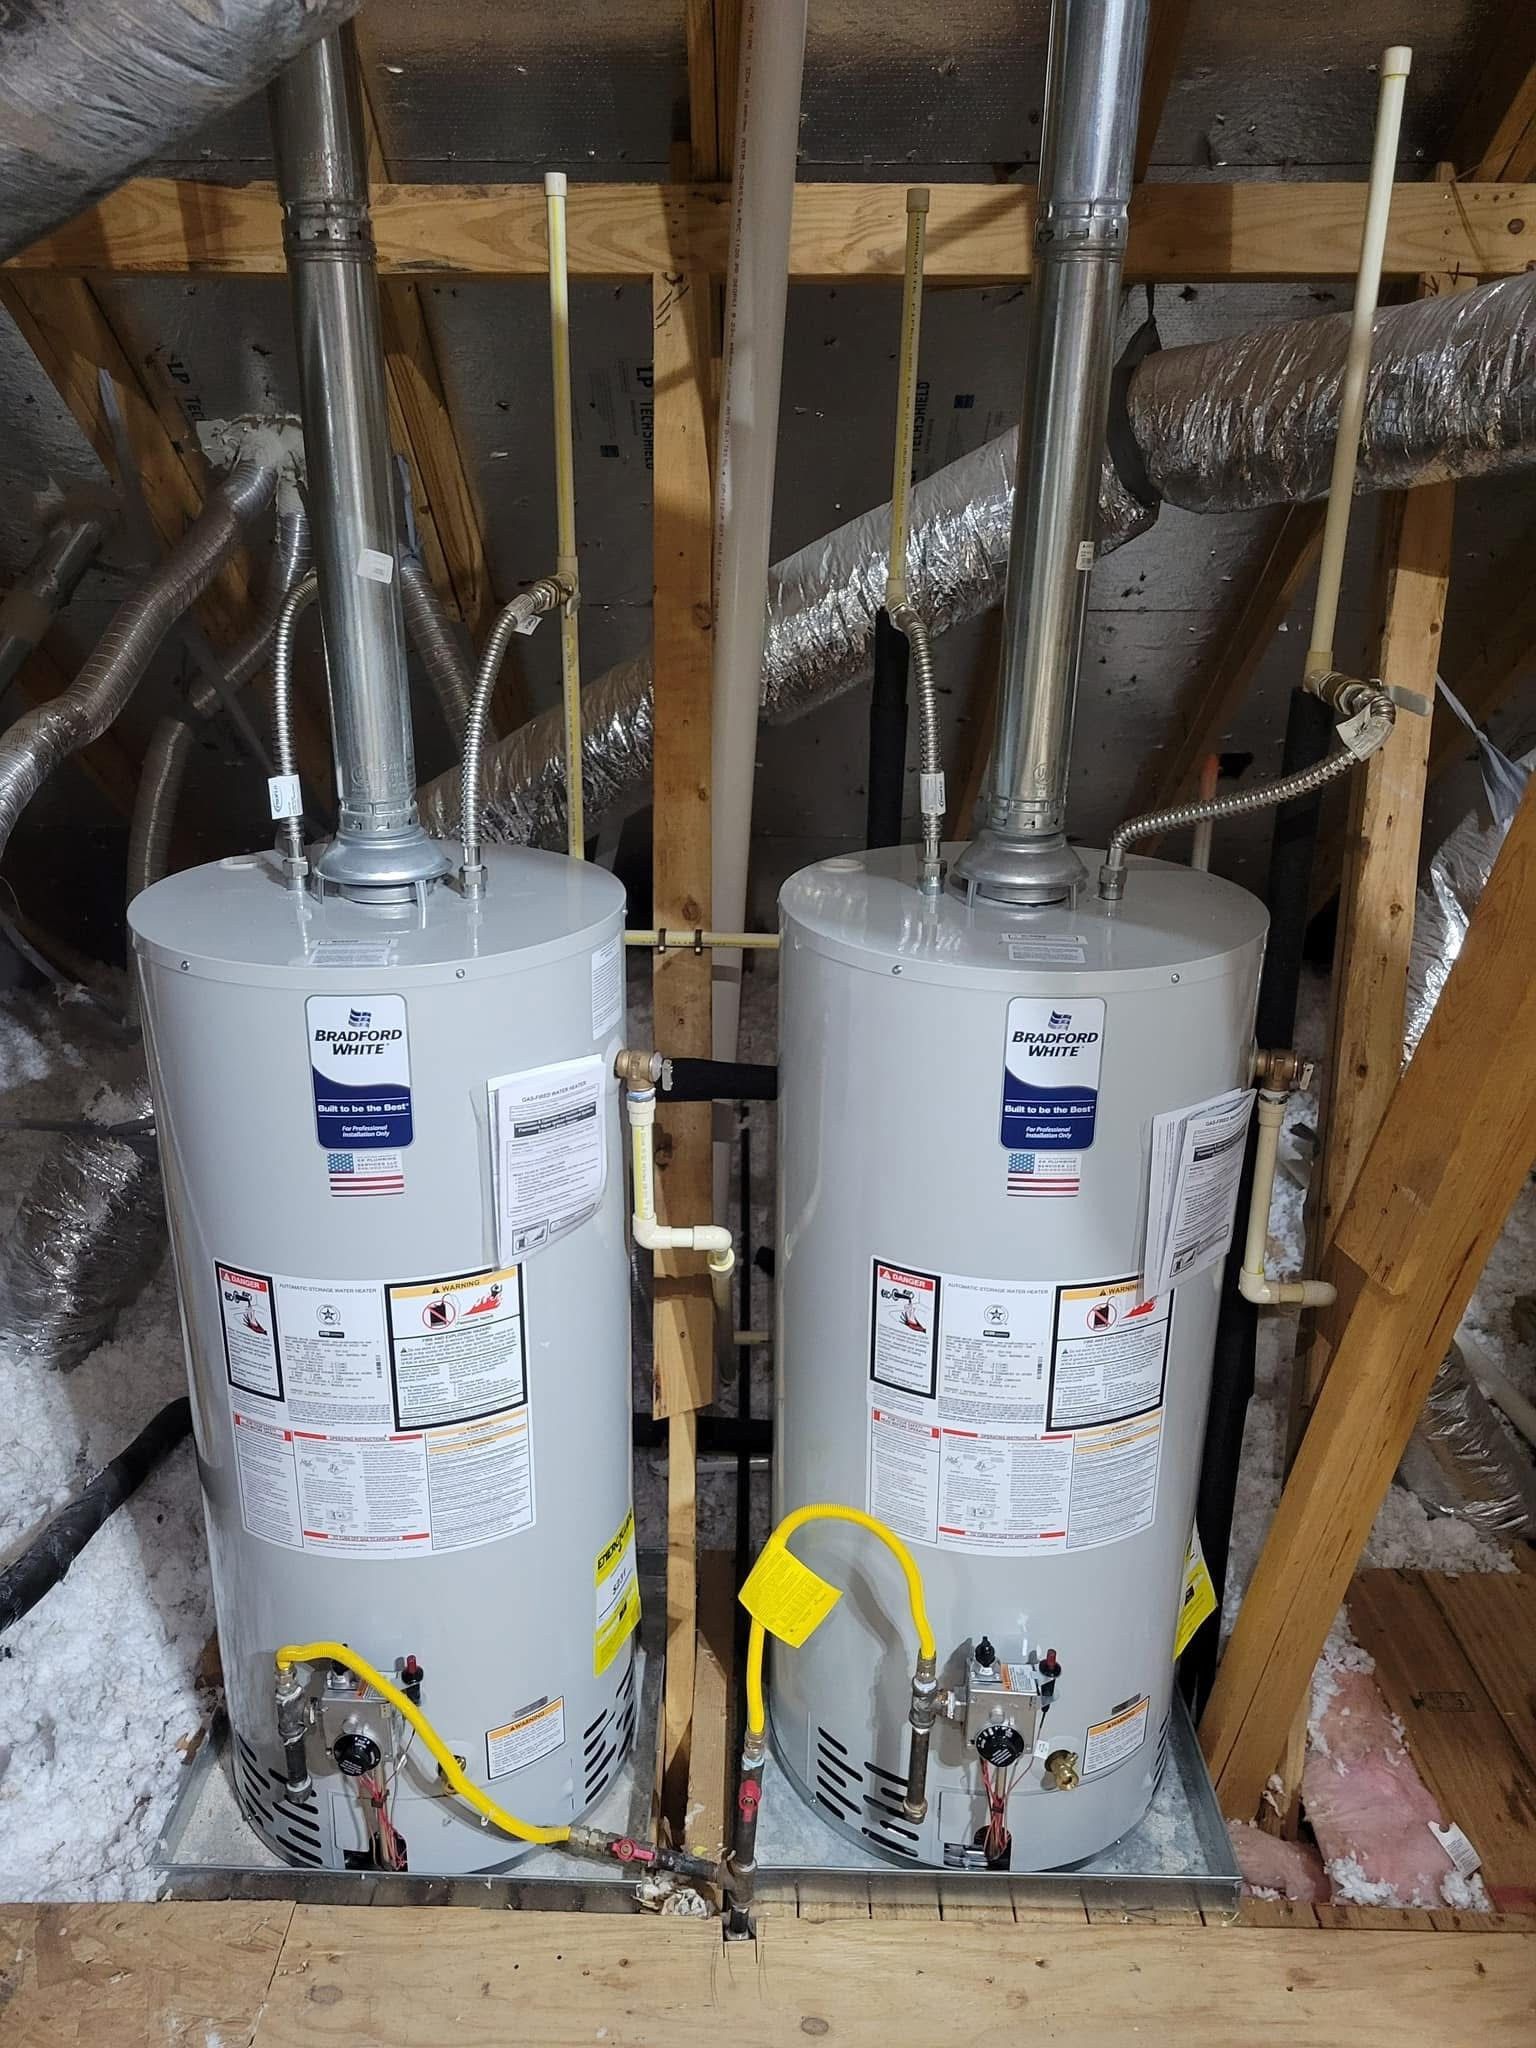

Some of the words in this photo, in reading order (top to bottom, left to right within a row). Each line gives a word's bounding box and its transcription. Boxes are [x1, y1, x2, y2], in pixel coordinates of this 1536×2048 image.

[637, 366, 654, 388] LP
[640, 402, 654, 470] TECHSHIELD
[315, 1029, 402, 1042] BRADFORD
[1012, 1031, 1099, 1043] BRADFORD
[332, 1043, 385, 1055] WHITE
[1028, 1045, 1080, 1057] WHITE
[318, 1104, 338, 1112] Built
[366, 1104, 382, 1112] the
[1005, 1105, 1025, 1113] Built
[231, 1274, 261, 1289] DANGER
[442, 1279, 480, 1292] WARNING
[892, 1273, 926, 1288] DANGER
[1108, 1283, 1141, 1295] WARNIN
